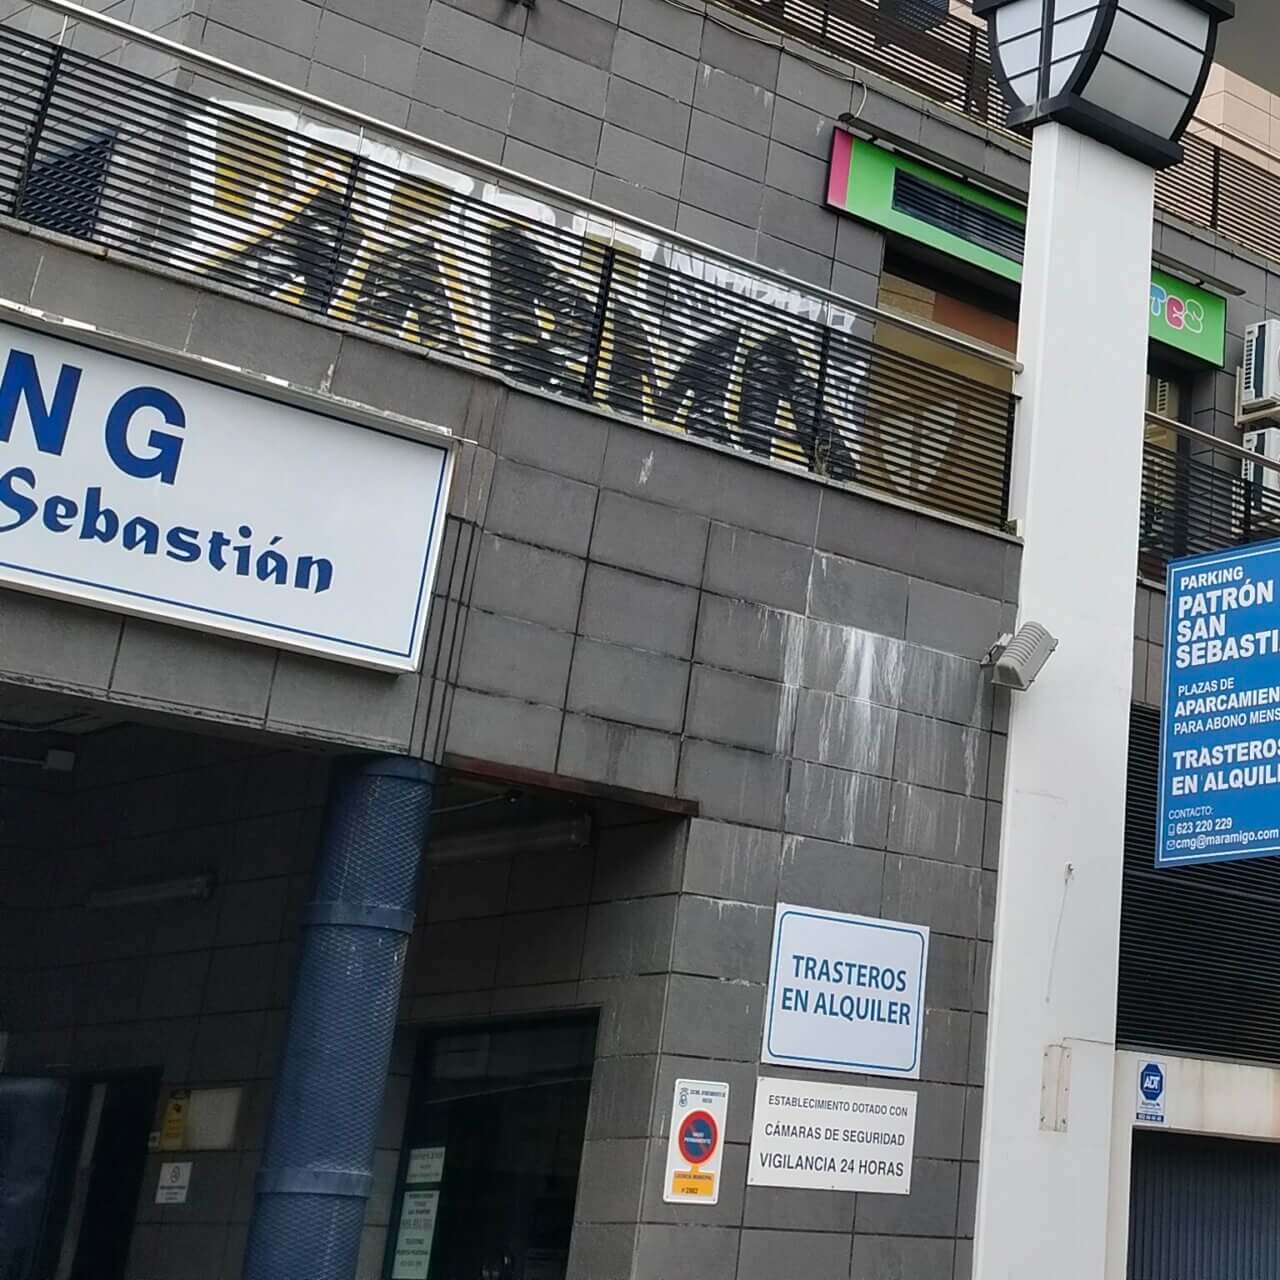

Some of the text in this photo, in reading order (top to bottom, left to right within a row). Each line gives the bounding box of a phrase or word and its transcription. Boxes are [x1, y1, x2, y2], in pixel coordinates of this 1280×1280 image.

[0, 466, 333, 593] Sebastián
[1180, 566, 1244, 591] PARKING
[1178, 578, 1274, 619] PATRÓN
[1176, 613, 1226, 643] SAN
[1178, 677, 1235, 697] PLAZAS DE
[1174, 720, 1204, 736] PARA
[1205, 712, 1247, 731] ABONO
[1171, 774, 1198, 796] EN
[1168, 806, 1214, 820] CONTACTO:
[1176, 817, 1232, 835] 623 220 229
[1175, 828, 1279, 850] cmg@maramigo.com
[792, 954, 907, 992] TRASTEROS
[781, 987, 911, 1026] EN ALQUILER
[1143, 1075, 1160, 1089] ADT
[768, 1094, 908, 1117] ESTABLECIMIENTO DOTADO CON
[765, 1120, 905, 1146] CÁMARAS DE SEGURIDAD
[760, 1152, 904, 1177] VIGILANCIA 24 HORAS
